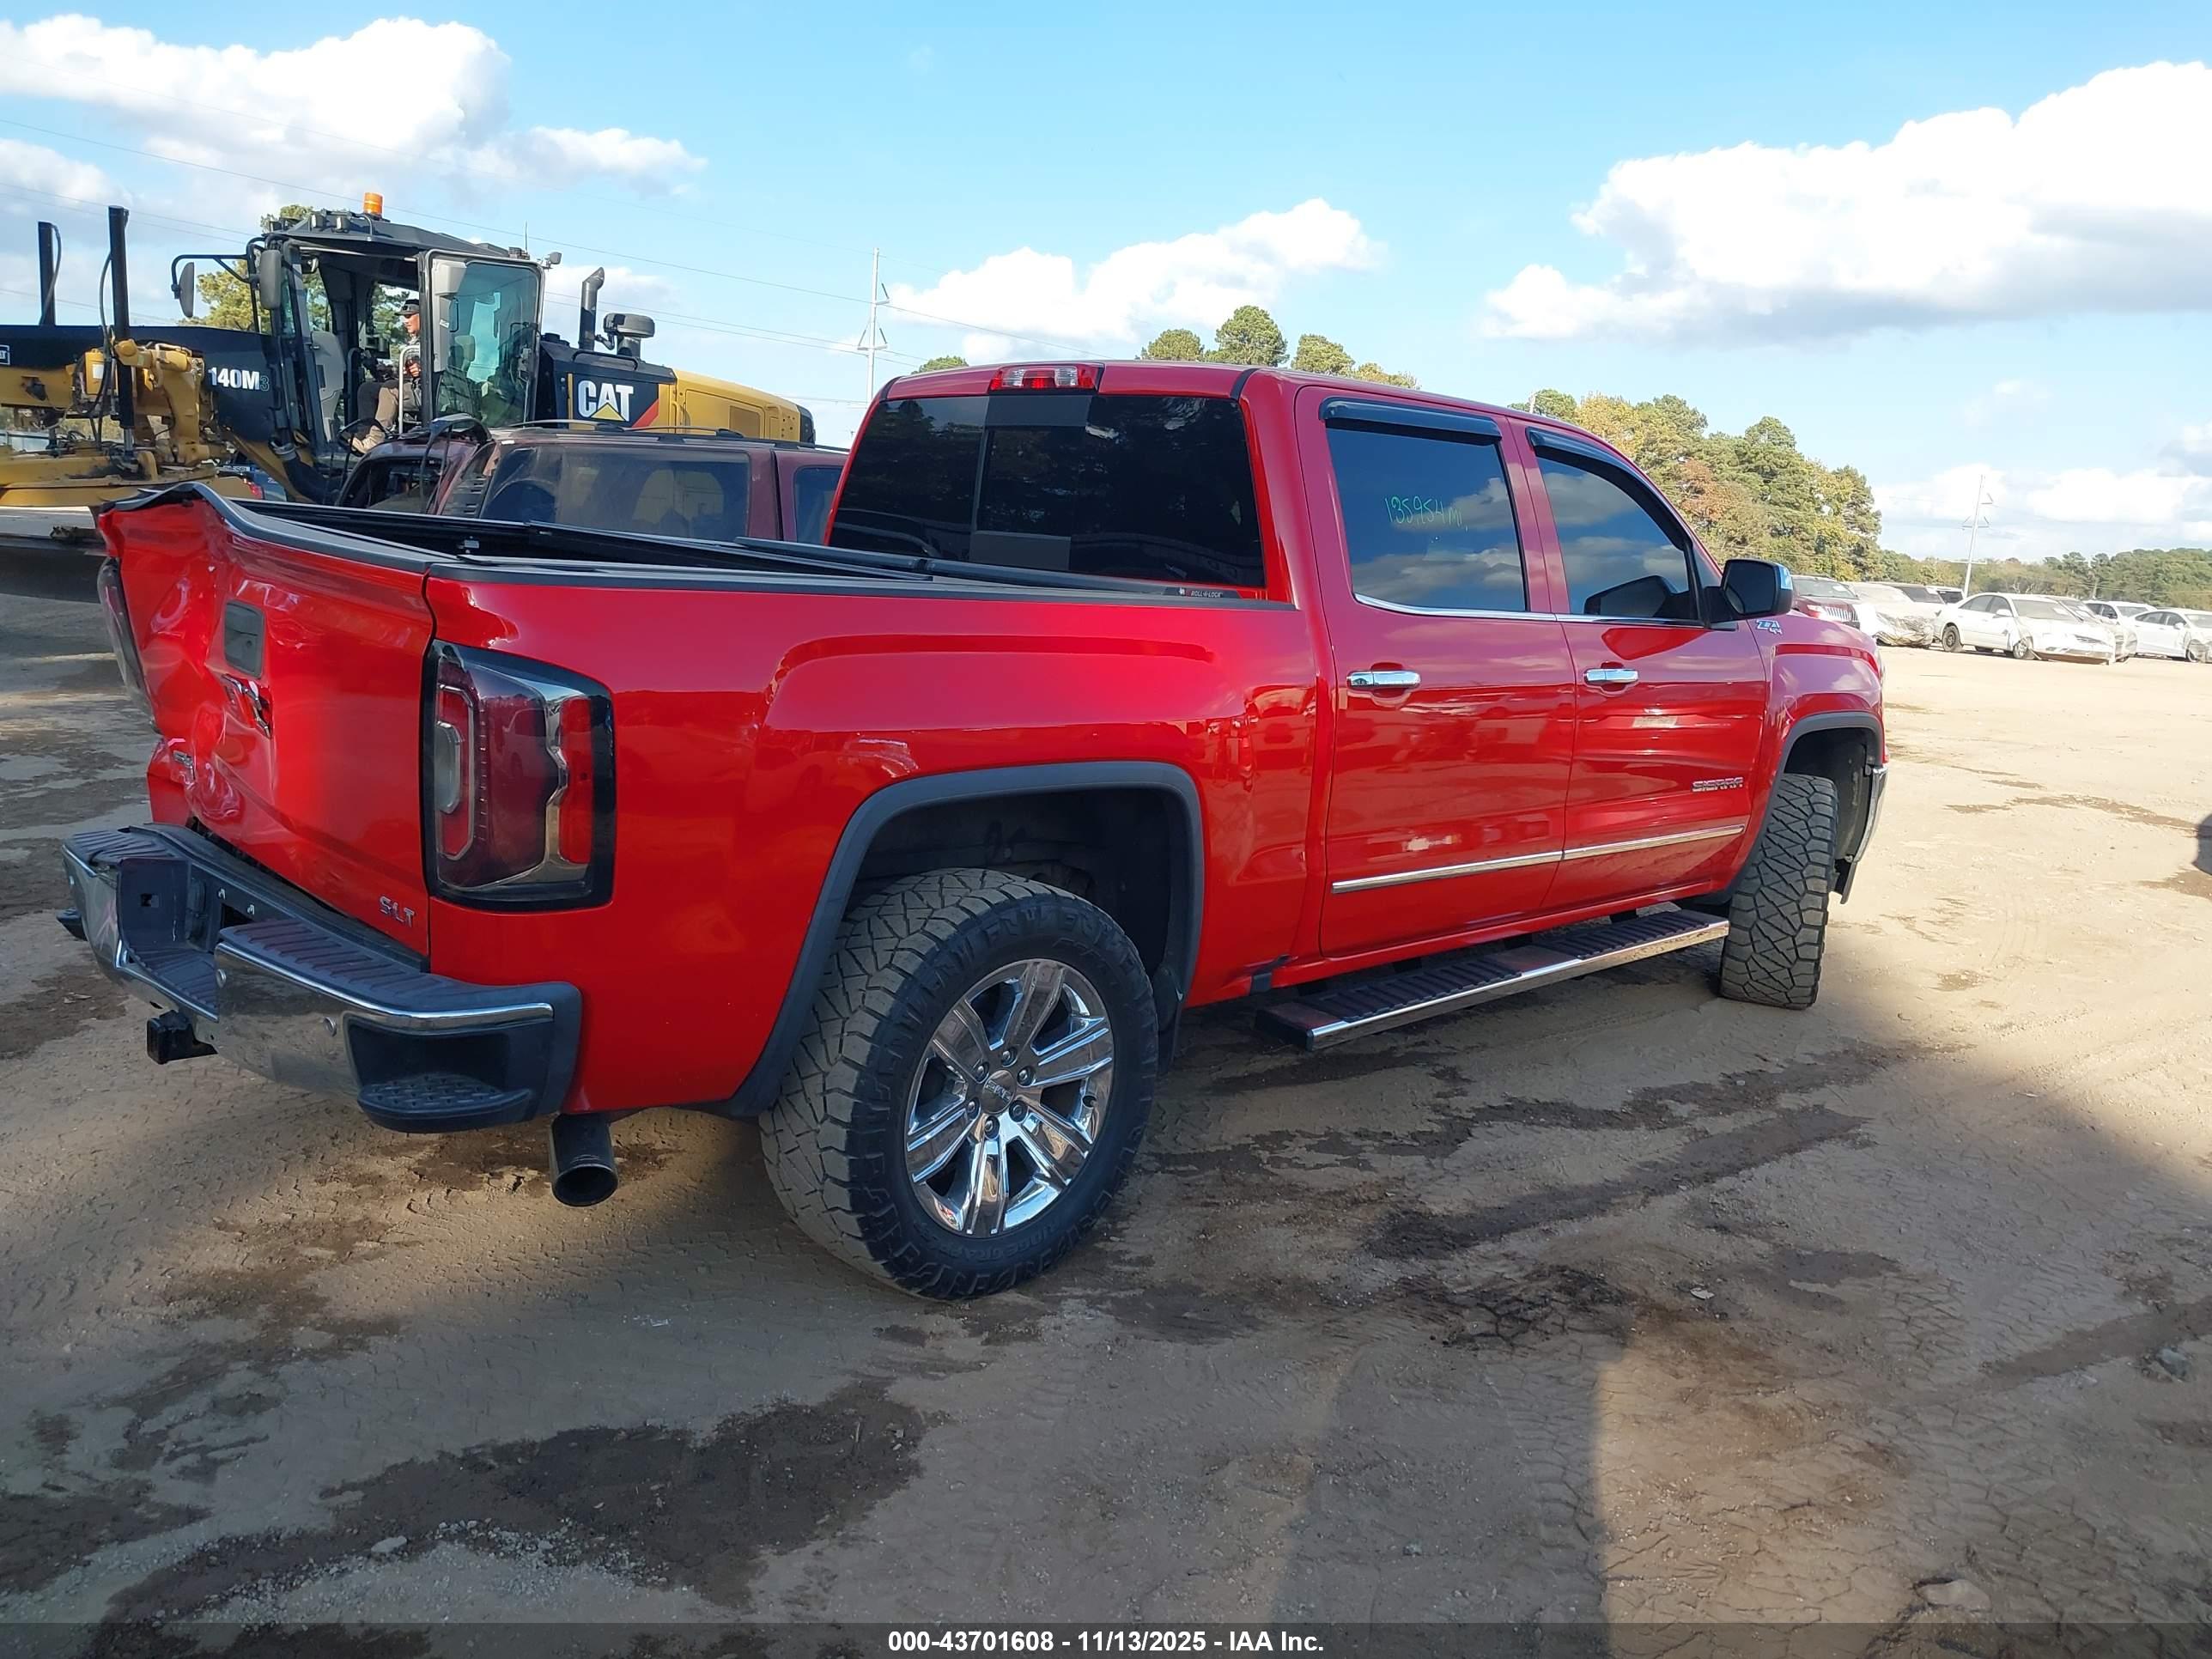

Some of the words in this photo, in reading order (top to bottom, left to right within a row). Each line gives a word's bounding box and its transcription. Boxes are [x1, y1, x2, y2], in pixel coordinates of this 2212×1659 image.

[578, 380, 634, 422] CAT
[1692, 777, 1743, 792] SIERRA
[380, 896, 415, 927] SLT
